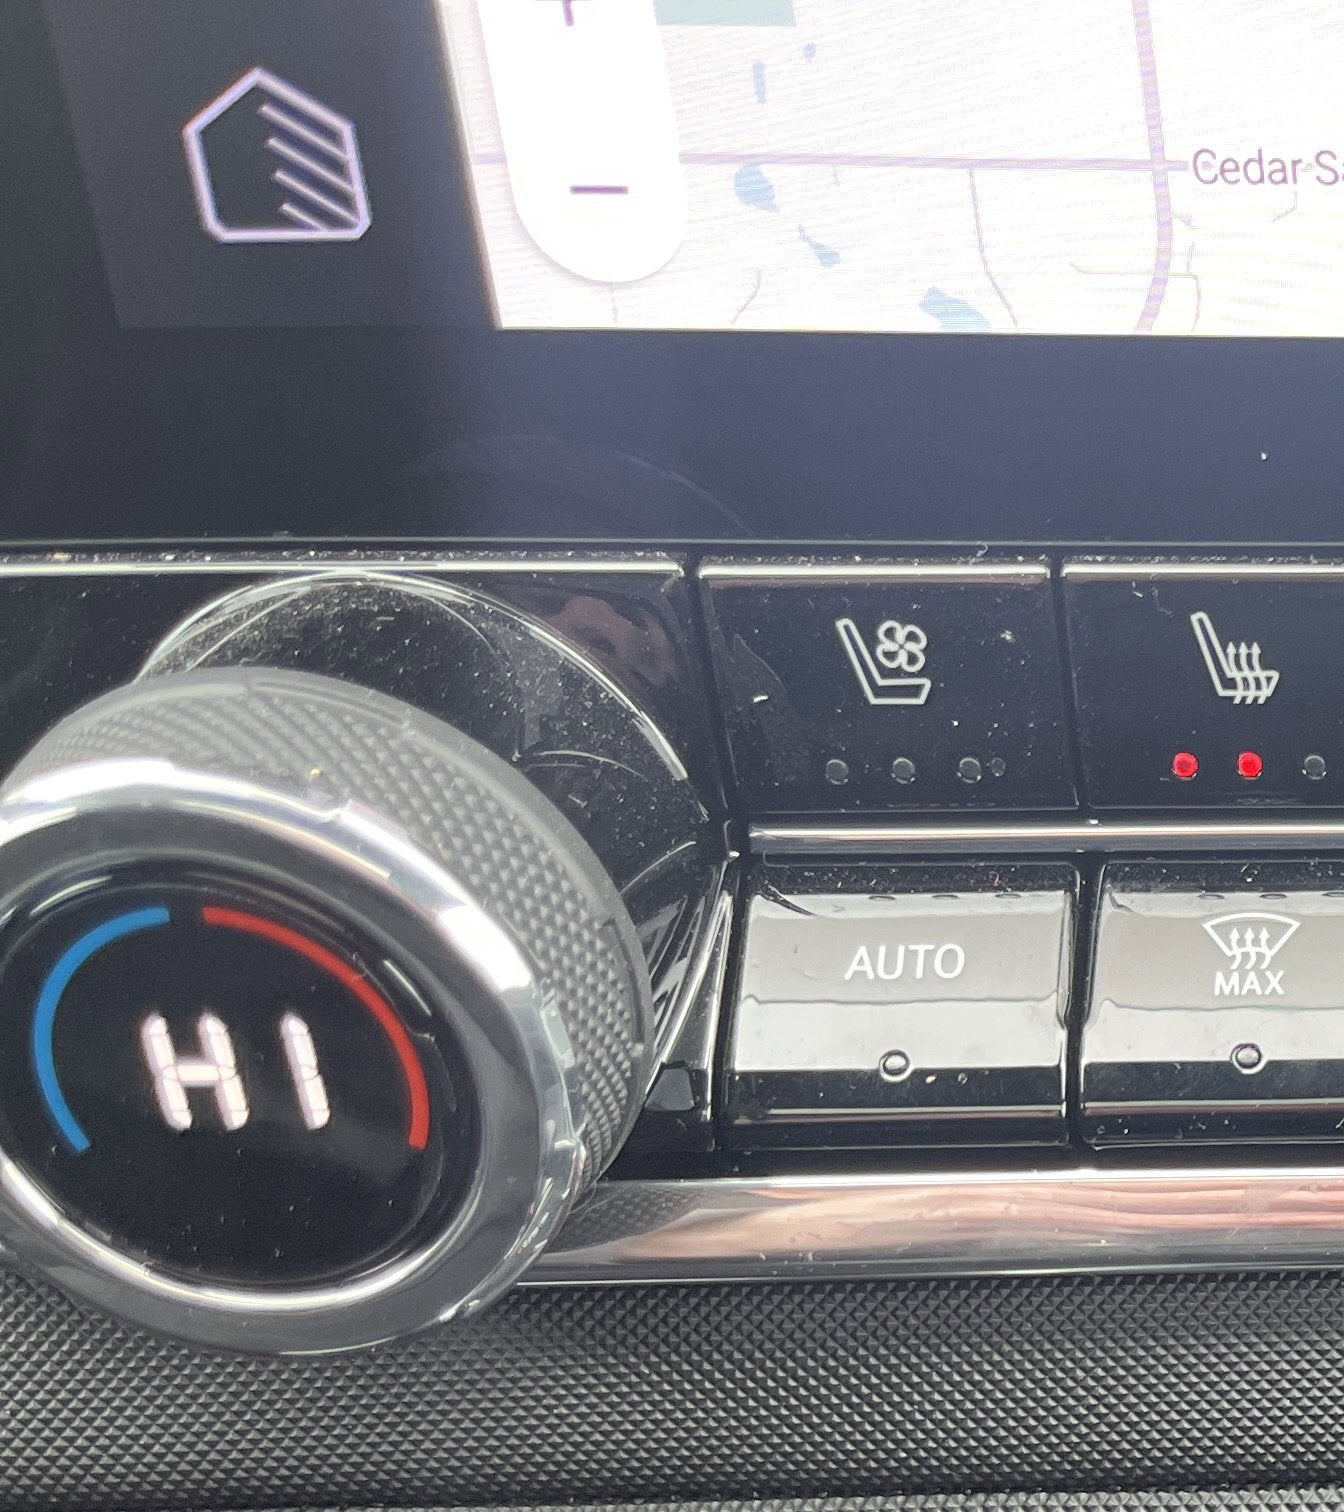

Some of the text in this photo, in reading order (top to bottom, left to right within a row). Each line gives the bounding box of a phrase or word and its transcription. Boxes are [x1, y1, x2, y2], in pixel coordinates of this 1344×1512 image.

[1191, 148, 1303, 186] Cedar
[843, 943, 967, 982] AUTO
[1213, 970, 1286, 997] MAX
[139, 1011, 331, 1132] HI
